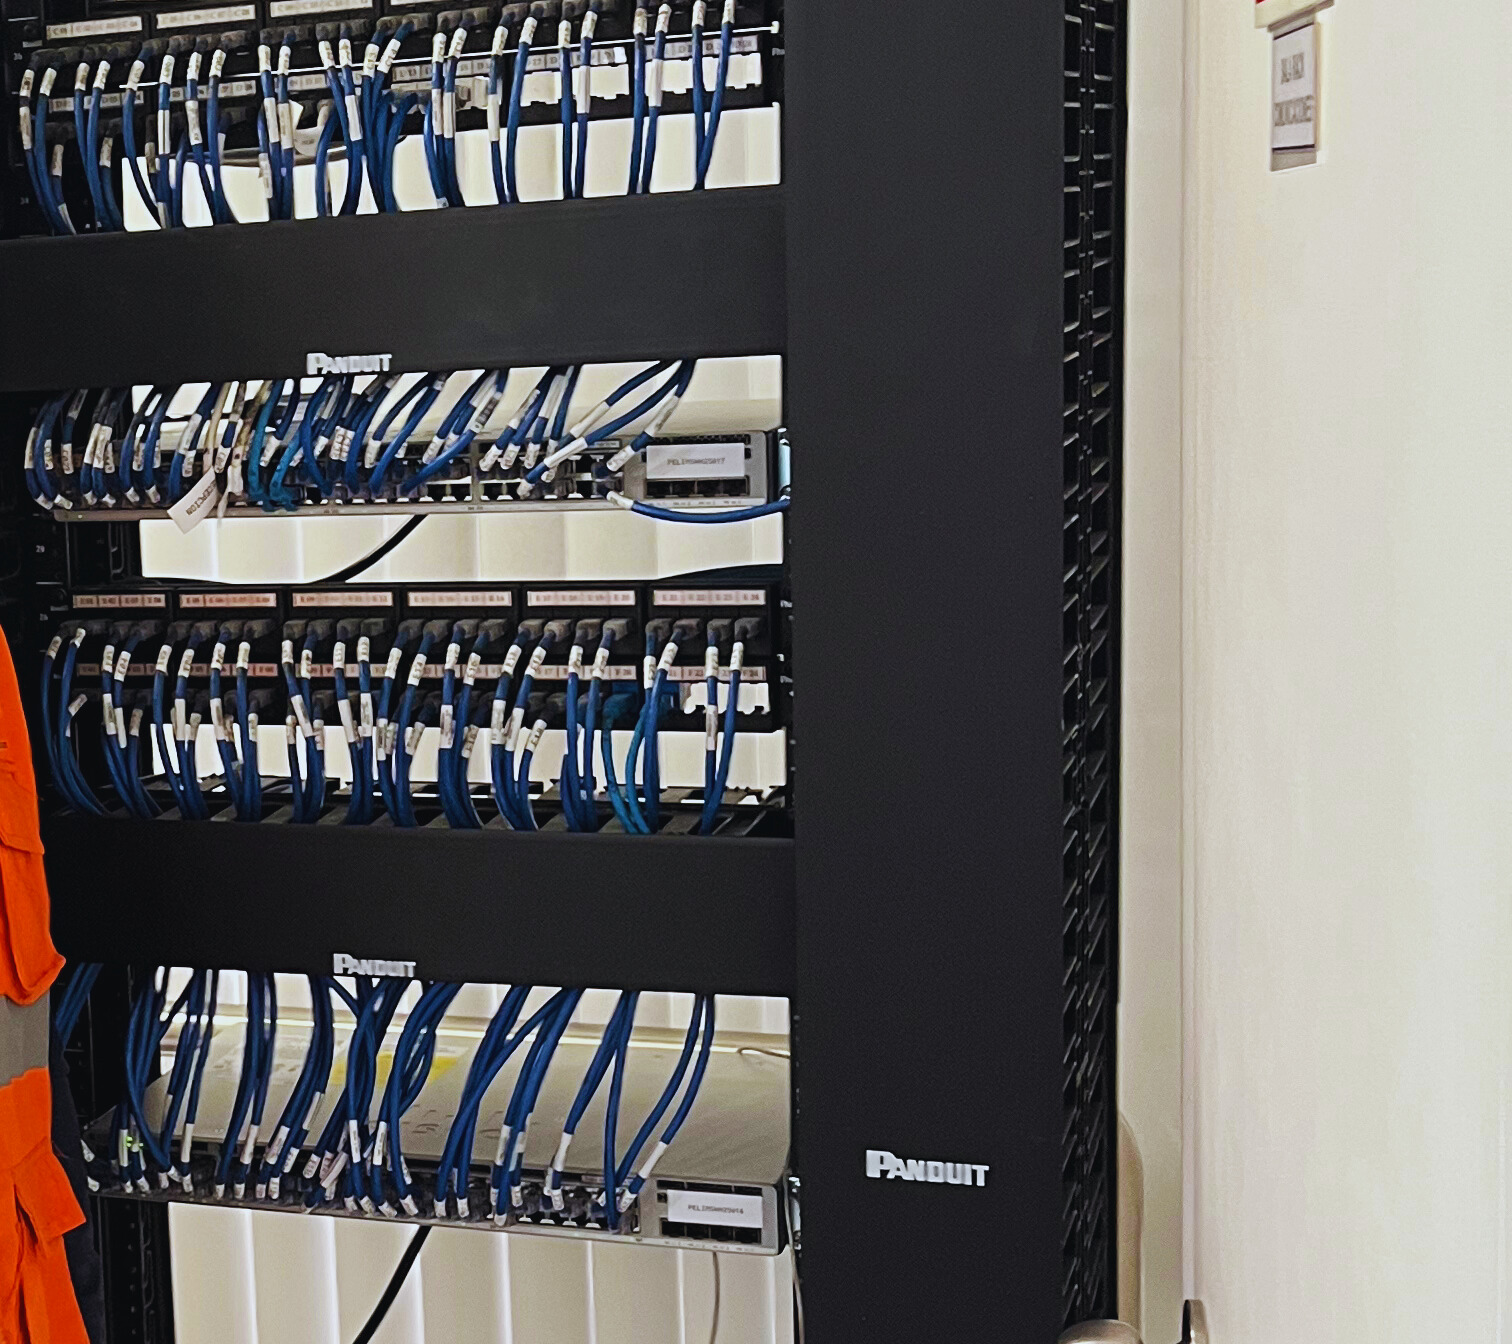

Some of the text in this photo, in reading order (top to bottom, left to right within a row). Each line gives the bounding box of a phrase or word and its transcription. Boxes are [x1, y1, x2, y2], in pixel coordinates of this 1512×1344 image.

[306, 352, 393, 376] PANDUIT
[333, 953, 417, 990] PANDUIT
[865, 1149, 990, 1187] PANDUIT
